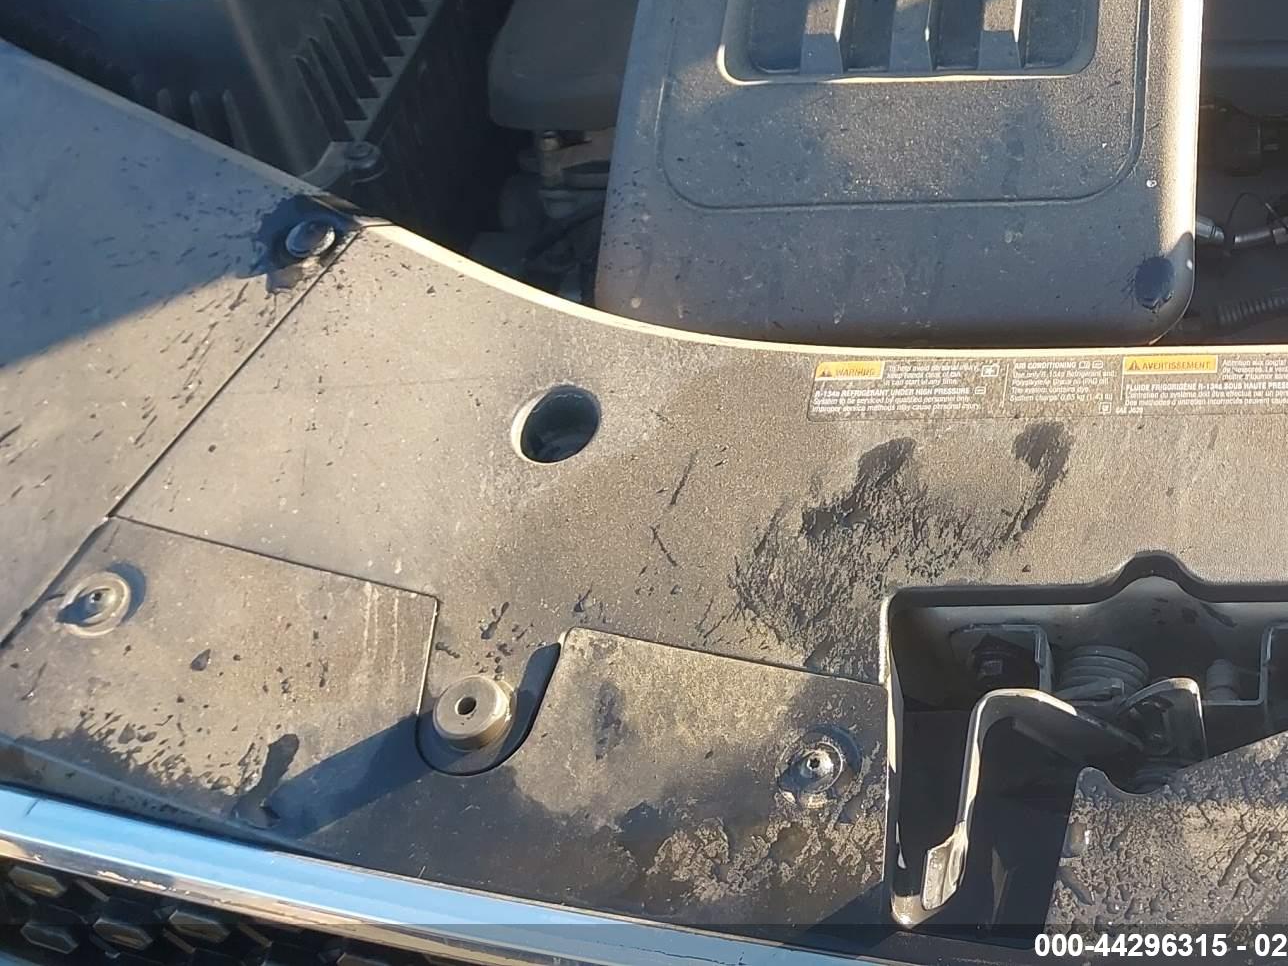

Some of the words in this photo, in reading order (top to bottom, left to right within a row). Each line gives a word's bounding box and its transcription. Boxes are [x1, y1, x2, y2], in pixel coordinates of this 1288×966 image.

[1142, 361, 1211, 370] AVERTISSEMENT
[835, 368, 875, 376] WARNING
[1126, 383, 1150, 391] FLUIDE
[841, 389, 889, 397] REFRIGERANT
[916, 388, 933, 396] HIGH
[934, 387, 970, 395] PRESSURE
